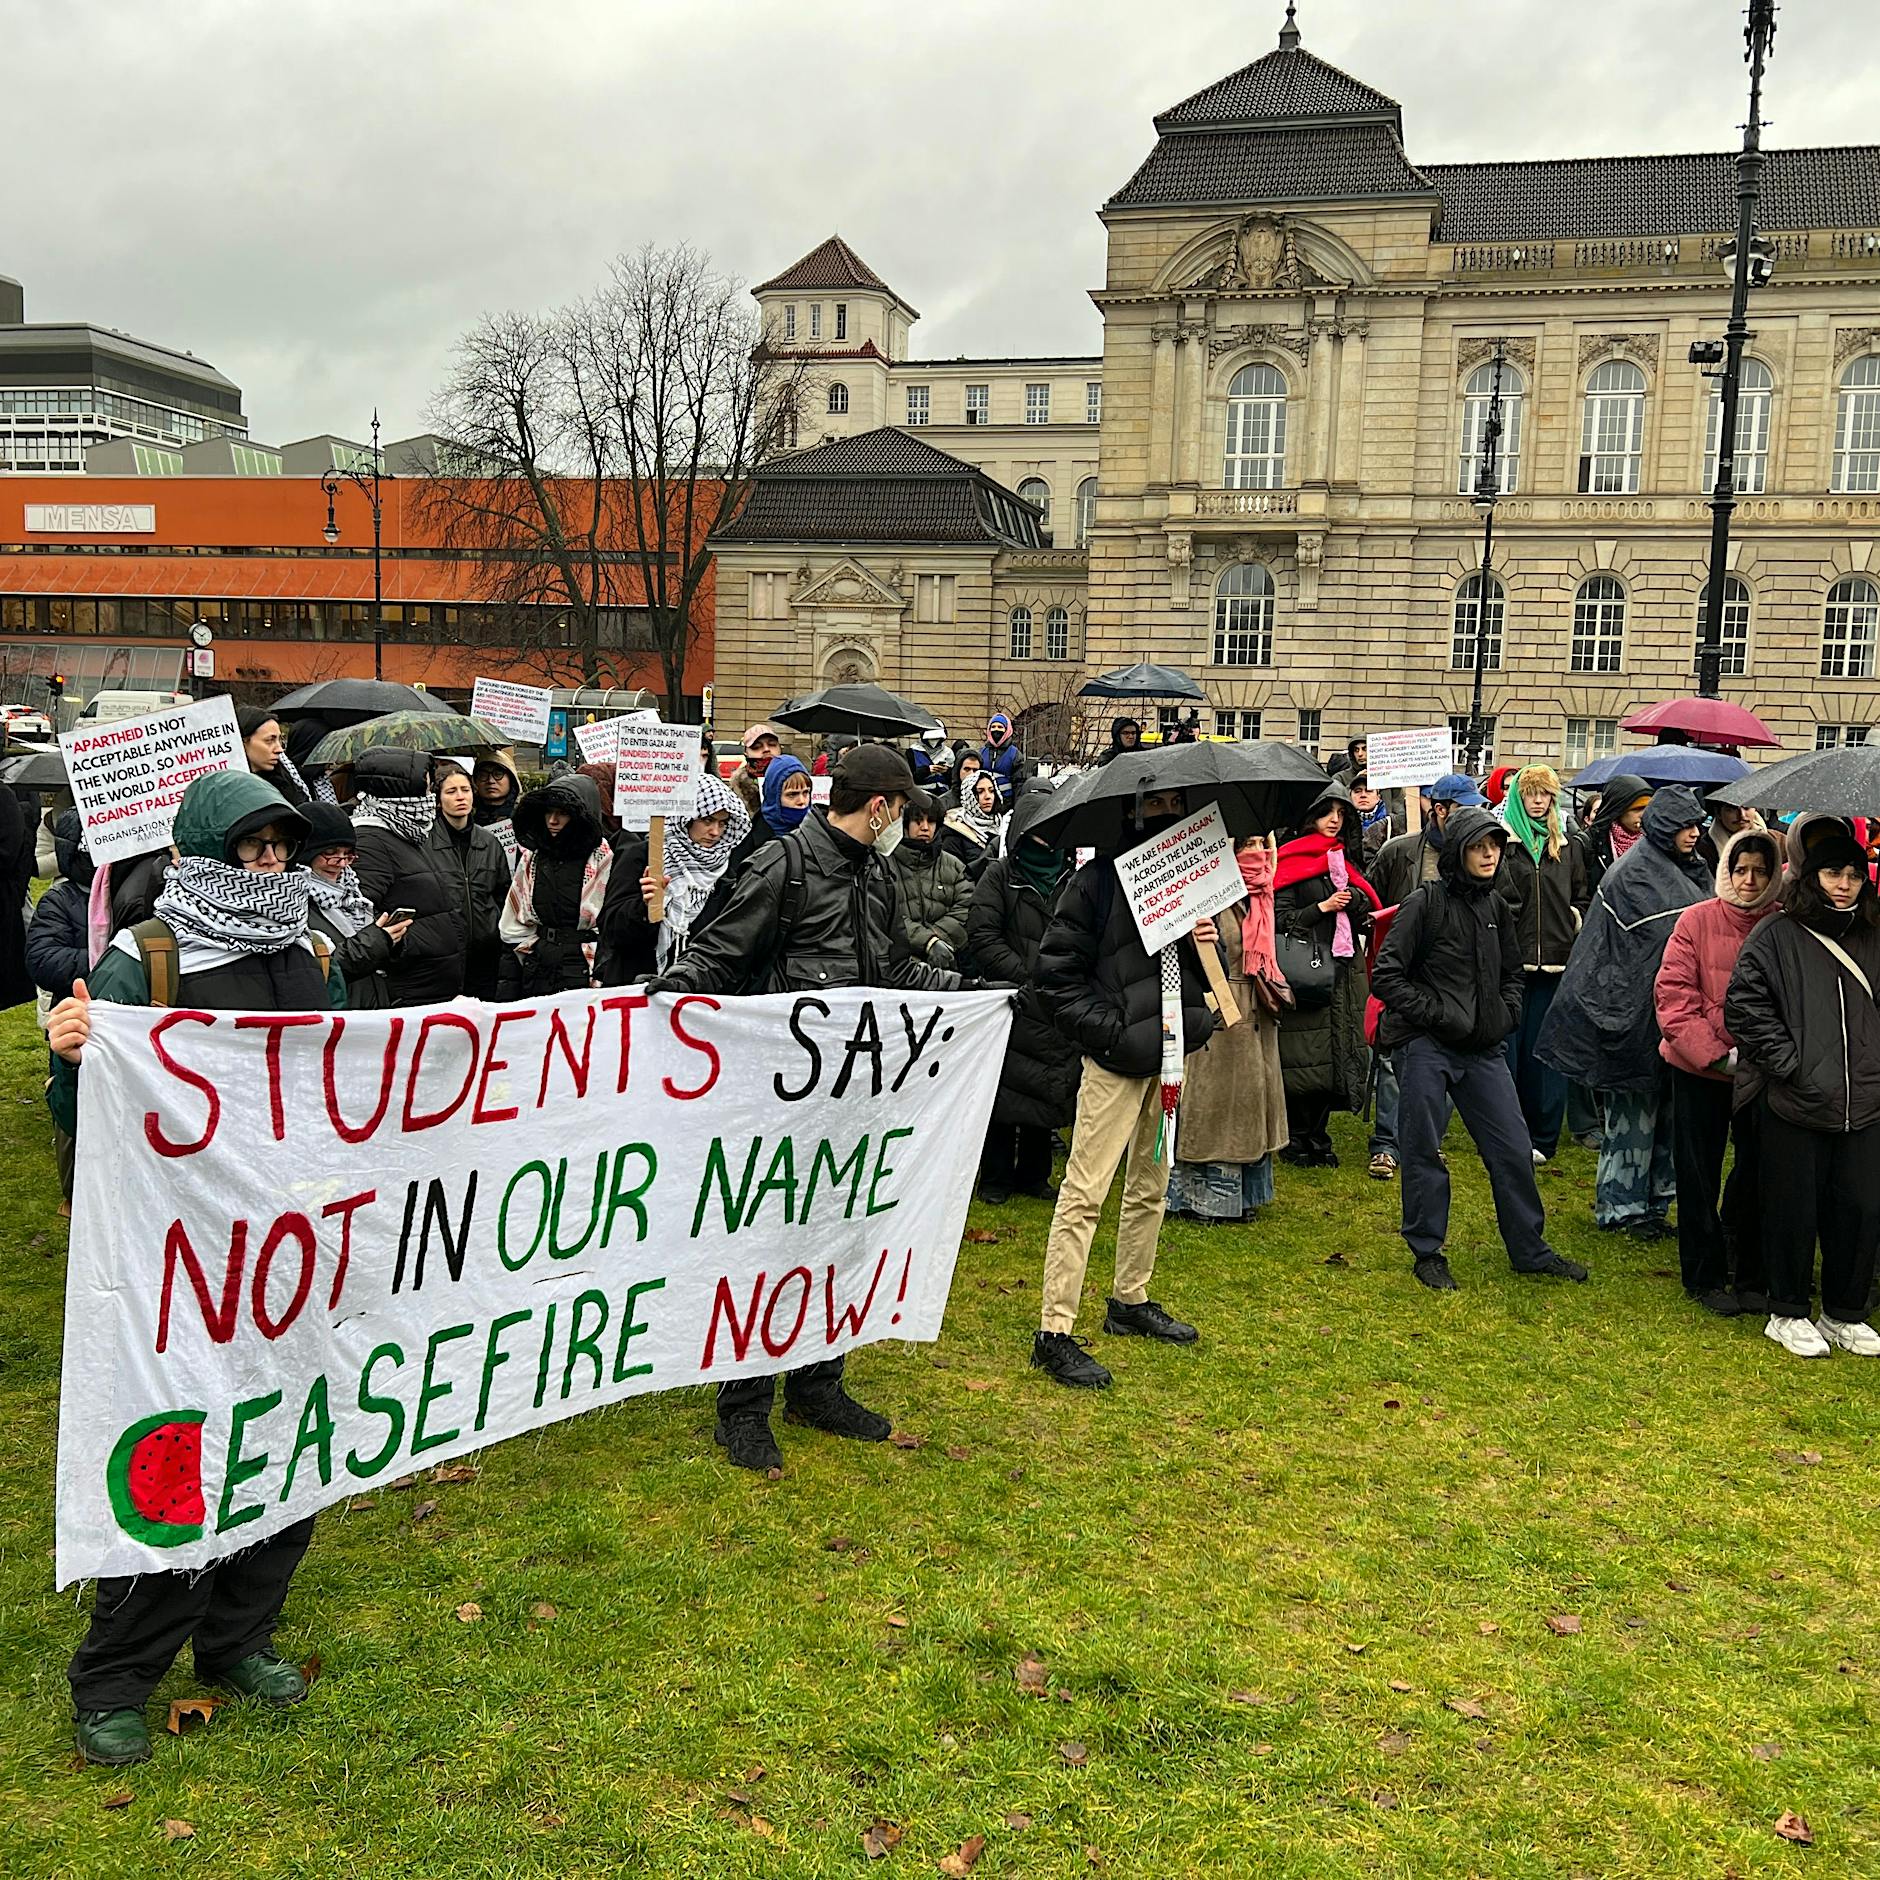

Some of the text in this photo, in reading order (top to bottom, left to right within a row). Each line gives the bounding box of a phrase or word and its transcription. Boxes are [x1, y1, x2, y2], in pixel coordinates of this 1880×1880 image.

[43, 505, 138, 530] MENSA
[145, 723, 157, 737] IS
[159, 716, 187, 733] NOT
[581, 732, 611, 744] HISTORY
[605, 722, 612, 730] IN
[636, 727, 652, 736] ONLY
[652, 728, 670, 737] THING
[670, 729, 686, 738] THAT
[72, 722, 235, 774] ACCEPTABLE ANYWHERE IN
[585, 744, 603, 752] SEEN
[588, 749, 611, 760] CRISIS
[619, 749, 685, 760] HUNDREDS OF TONS OF
[621, 737, 630, 746] TO
[630, 738, 648, 747] ENTER
[649, 738, 664, 748] GAZA
[665, 740, 677, 749] ARE
[75, 741, 233, 792] THE WORLD. SO WHY HAS
[619, 761, 654, 771] EXPLOSIVES
[654, 763, 670, 771] FROM
[671, 763, 682, 772] THE
[641, 773, 652, 782] NOT
[653, 774, 662, 782] AN
[662, 775, 682, 783] OUNCE
[80, 793, 107, 810] THE
[107, 780, 156, 803] WORLD
[618, 784, 662, 794] HUMANITARIAN
[87, 802, 145, 828] AGAINST
[94, 819, 165, 846] ORGANISATION
[1142, 848, 1158, 865] ARE
[1157, 831, 1188, 854] FAILING
[1166, 851, 1182, 865] THE
[1181, 837, 1206, 856] LAND,
[1133, 837, 1227, 901] APARTHEID RULES. THIS IS
[1138, 857, 1221, 915] A TEXT-BOOK CASE OF
[1163, 879, 1241, 932] UN HUMAN RIGHTS LAWYER
[144, 996, 955, 1158] STUDENTS SAY:
[156, 1127, 914, 1353] NOT IN OUR NAME
[107, 1248, 913, 1548] CEASEFIRE NOW!
